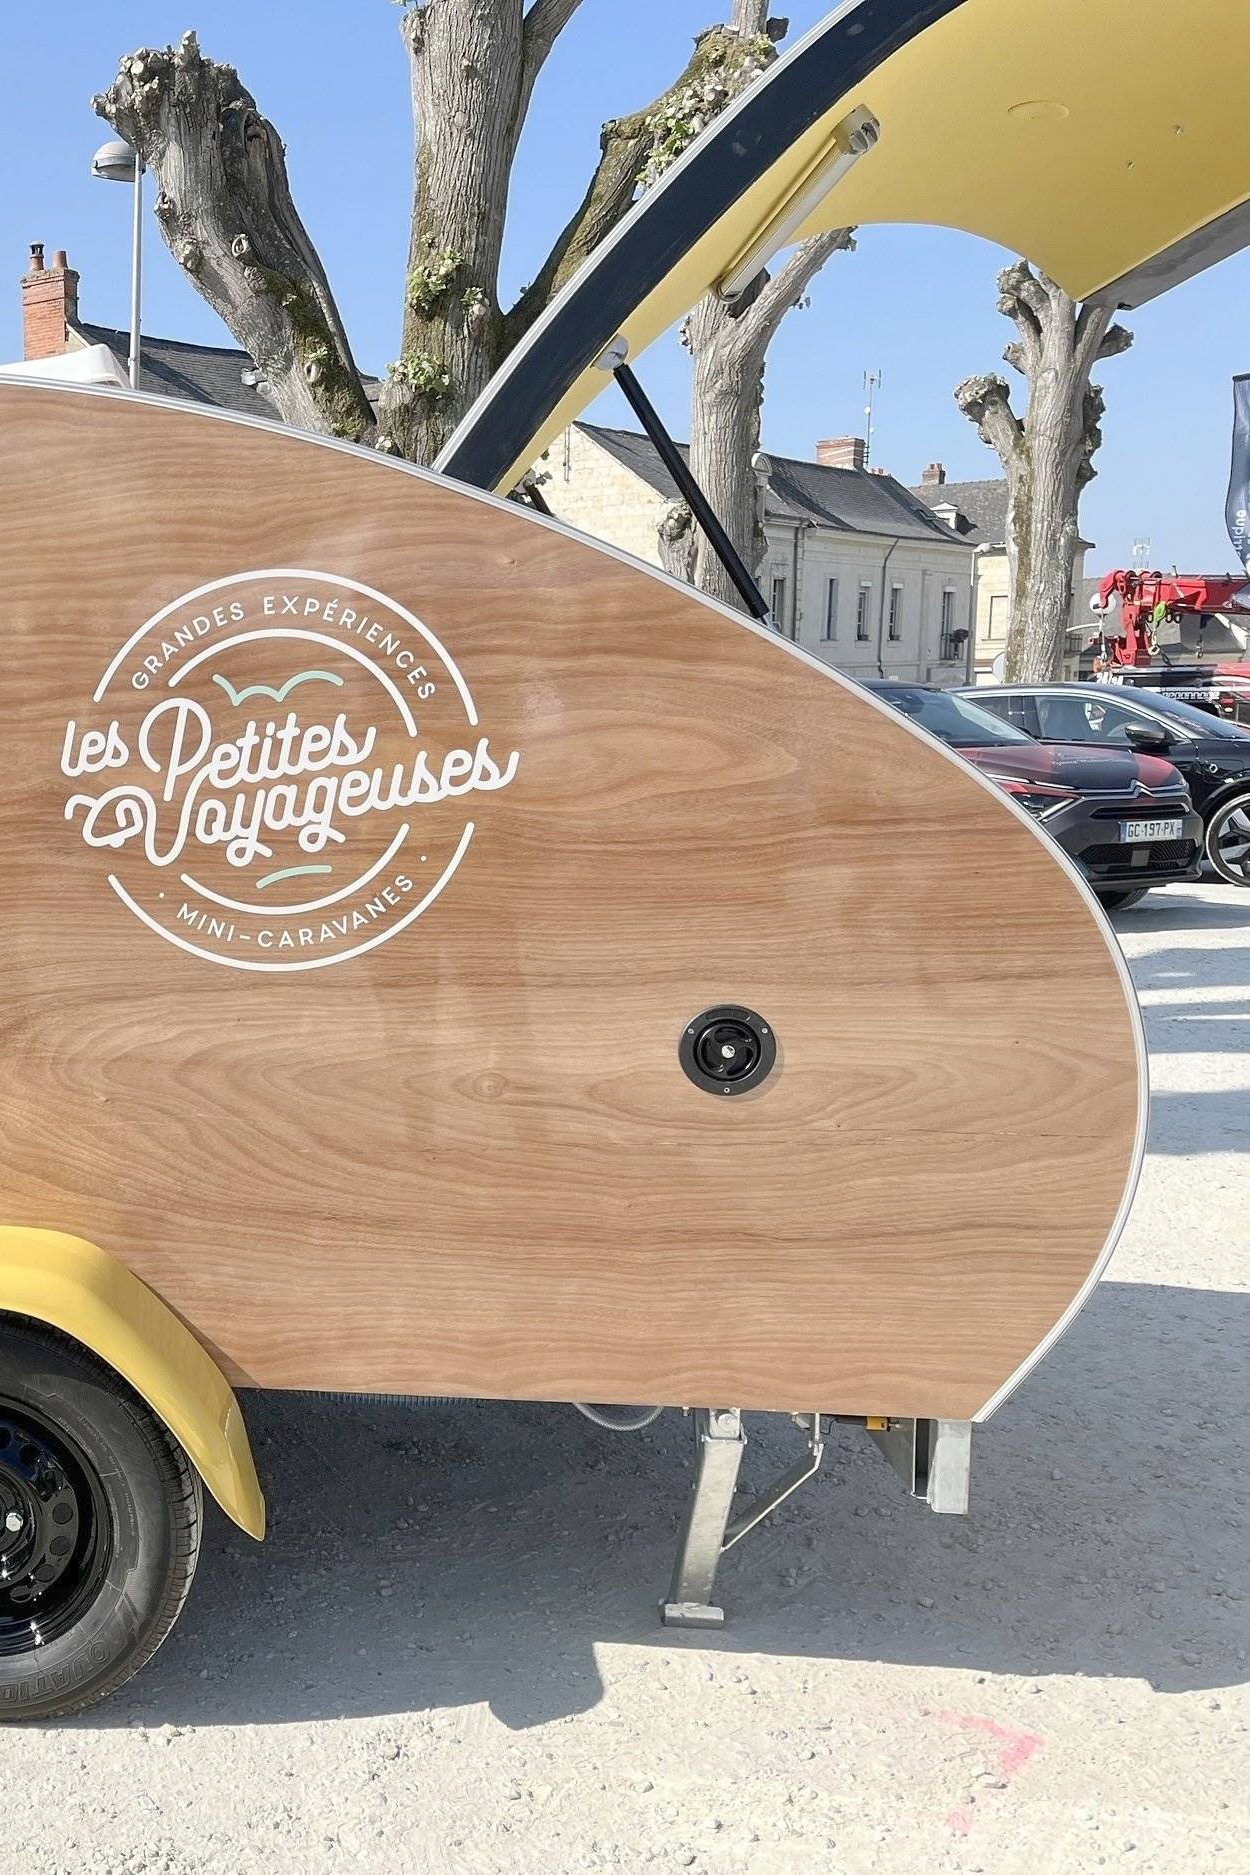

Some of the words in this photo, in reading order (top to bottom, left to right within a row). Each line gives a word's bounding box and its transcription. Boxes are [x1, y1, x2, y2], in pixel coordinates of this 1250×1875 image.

[131, 602, 245, 690] GRANDES
[263, 595, 436, 700] EXPÉRIENCES
[138, 697, 377, 801] Petites
[64, 737, 520, 867] Voyageuses
[176, 874, 414, 948] MINI-CARAVANES
